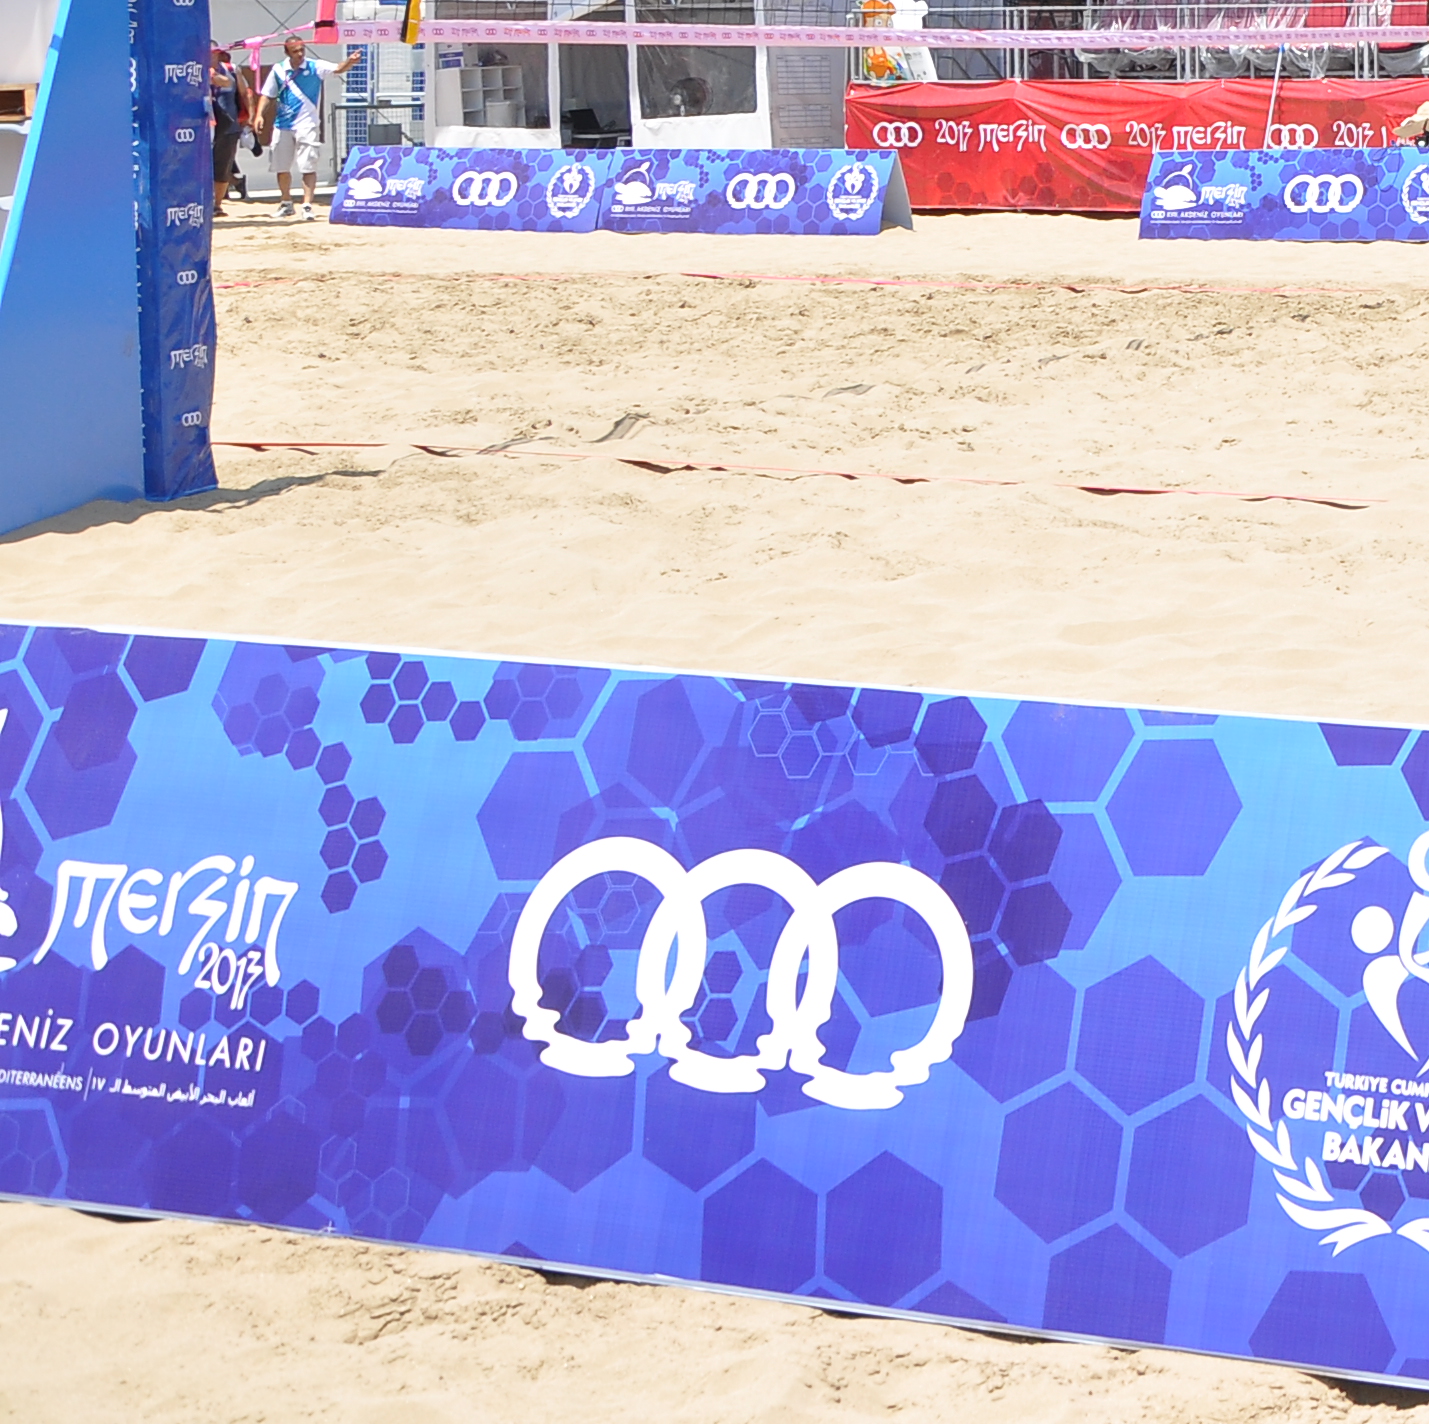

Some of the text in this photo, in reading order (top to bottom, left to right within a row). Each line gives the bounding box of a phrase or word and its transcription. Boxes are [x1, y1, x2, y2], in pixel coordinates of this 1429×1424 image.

[935, 119, 973, 152] 2013
[1125, 119, 1166, 150] 2013
[1333, 120, 1374, 148] 2013
[194, 942, 263, 1010] 2013
[92, 1022, 266, 1071] OYUNLARI
